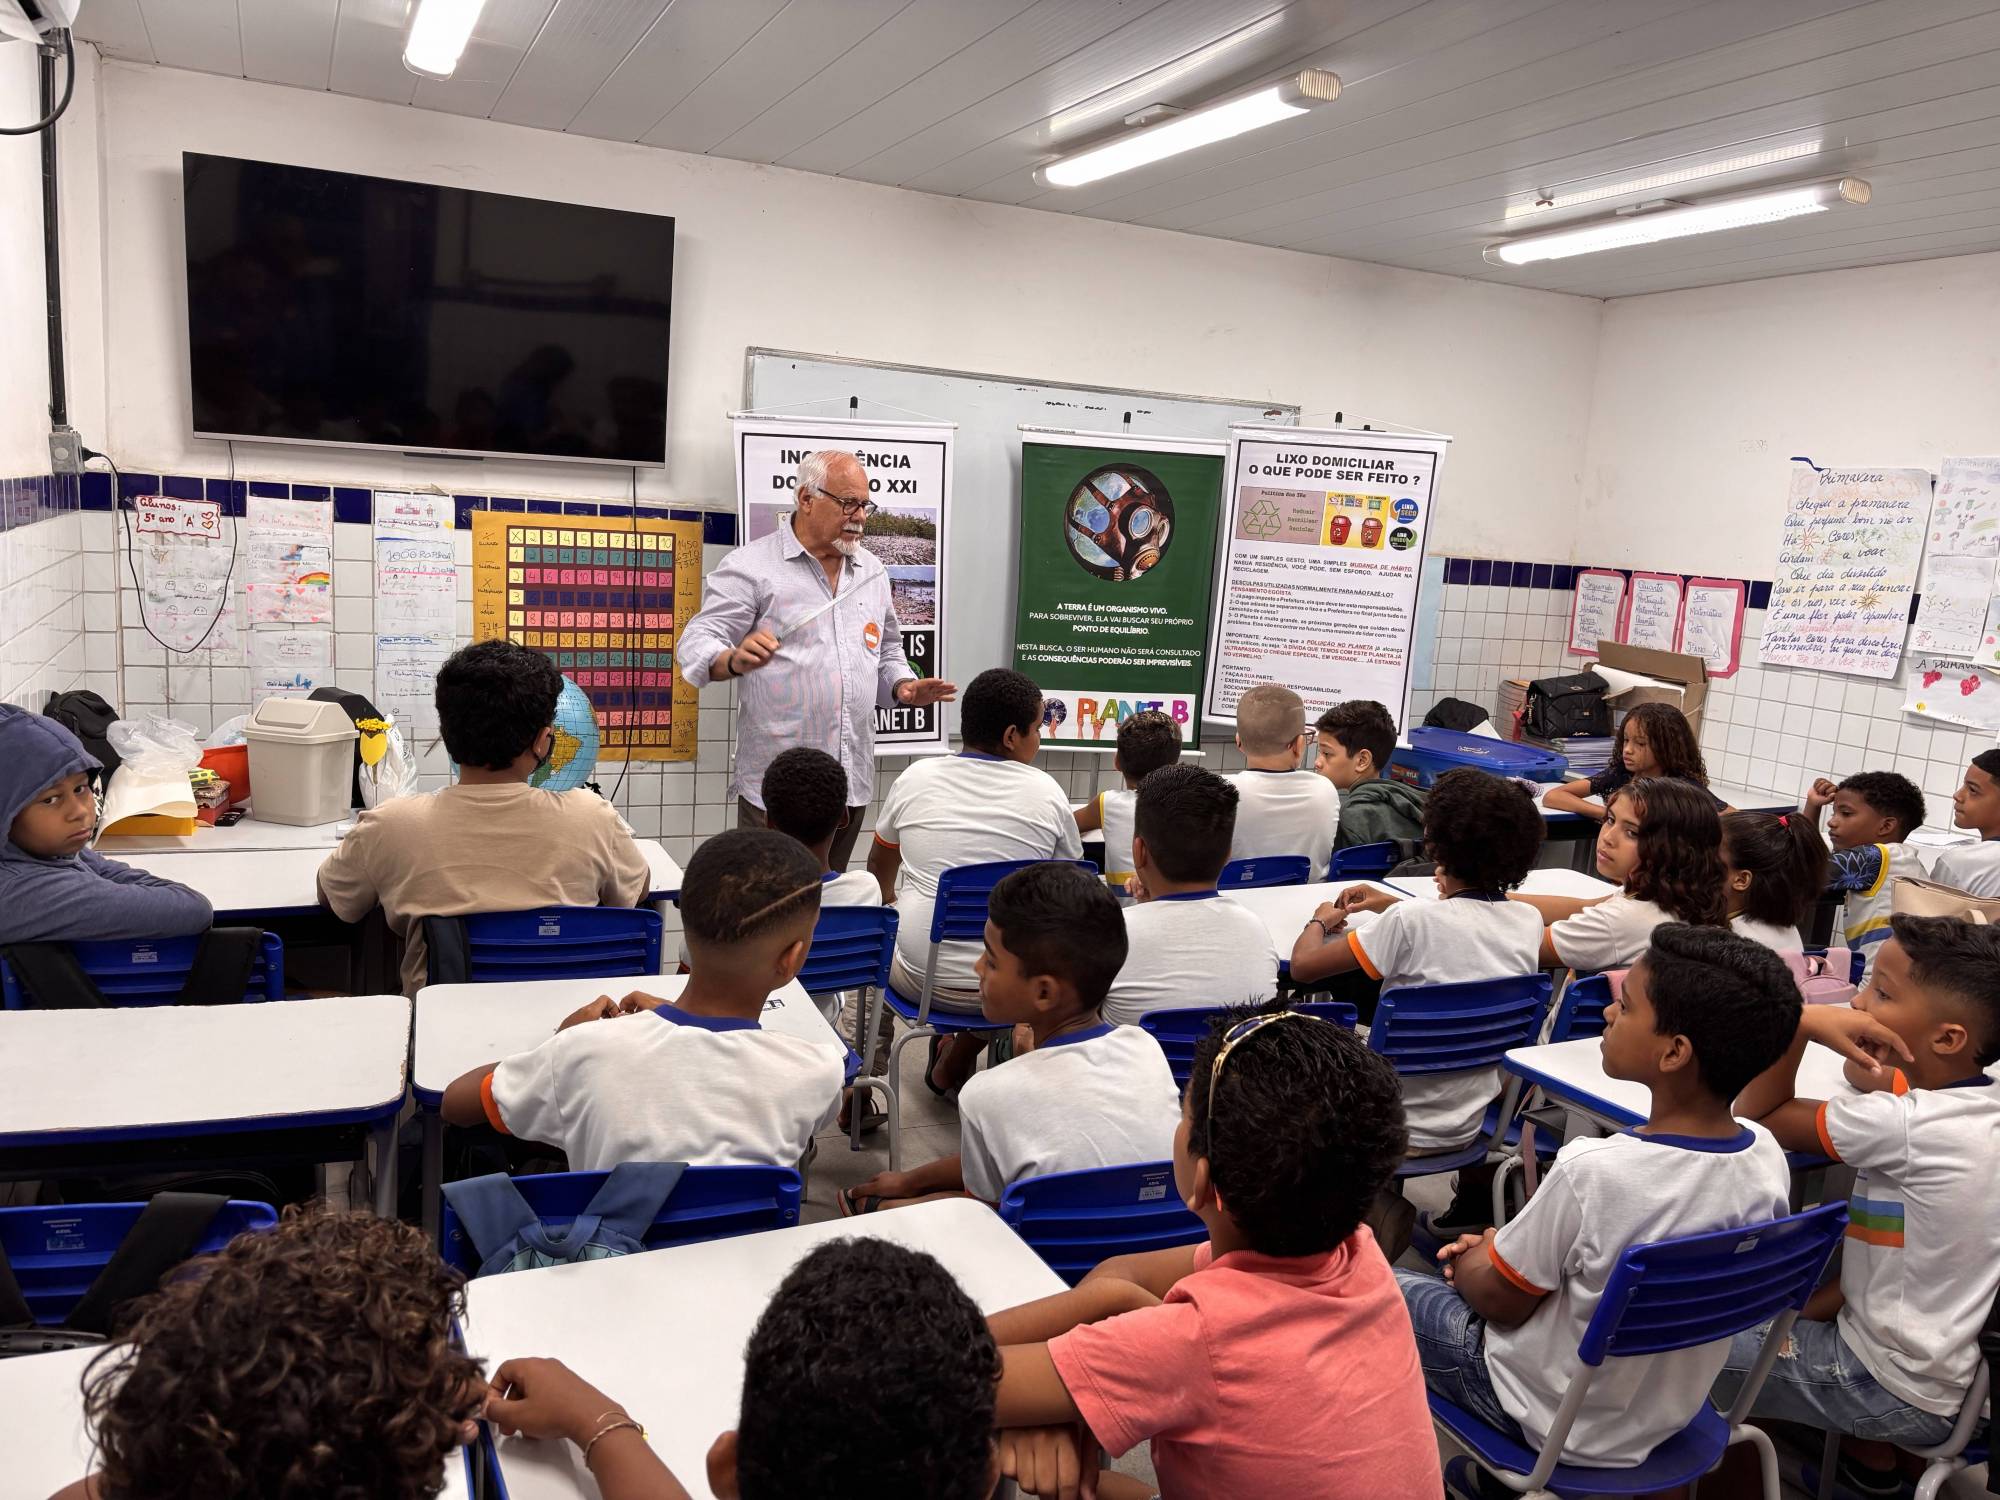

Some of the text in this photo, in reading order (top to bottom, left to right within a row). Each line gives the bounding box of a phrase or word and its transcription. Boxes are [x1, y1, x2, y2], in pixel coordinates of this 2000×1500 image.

[1276, 453, 1395, 470] LIXO DOMICILIAR
[1249, 465, 1420, 485] O QUE PODE SER FEITO ?
[887, 480, 916, 493] XXI
[1064, 603, 1086, 611] TERRA
[1087, 603, 1092, 611] É
[1106, 605, 1148, 614] ORGANISMO
[1150, 607, 1168, 615] VIVO.
[1029, 612, 1048, 620] PARA
[1050, 613, 1094, 622] SOBREVIVER,
[1122, 616, 1149, 624] BUSCAR
[1151, 617, 1163, 625] SEU
[1073, 625, 1099, 633] PONTO
[910, 634, 925, 656] IS
[1073, 645, 1086, 653] SER
[1087, 646, 1120, 654] HUMANO
[1121, 646, 1137, 655] NÃO
[1137, 647, 1154, 656] SERÁ
[1156, 649, 1201, 657] CONSULTADO
[1098, 656, 1132, 665] PODERÃO
[1133, 657, 1145, 665] SER
[1172, 700, 1189, 723] B
[874, 708, 925, 730] ANET B
